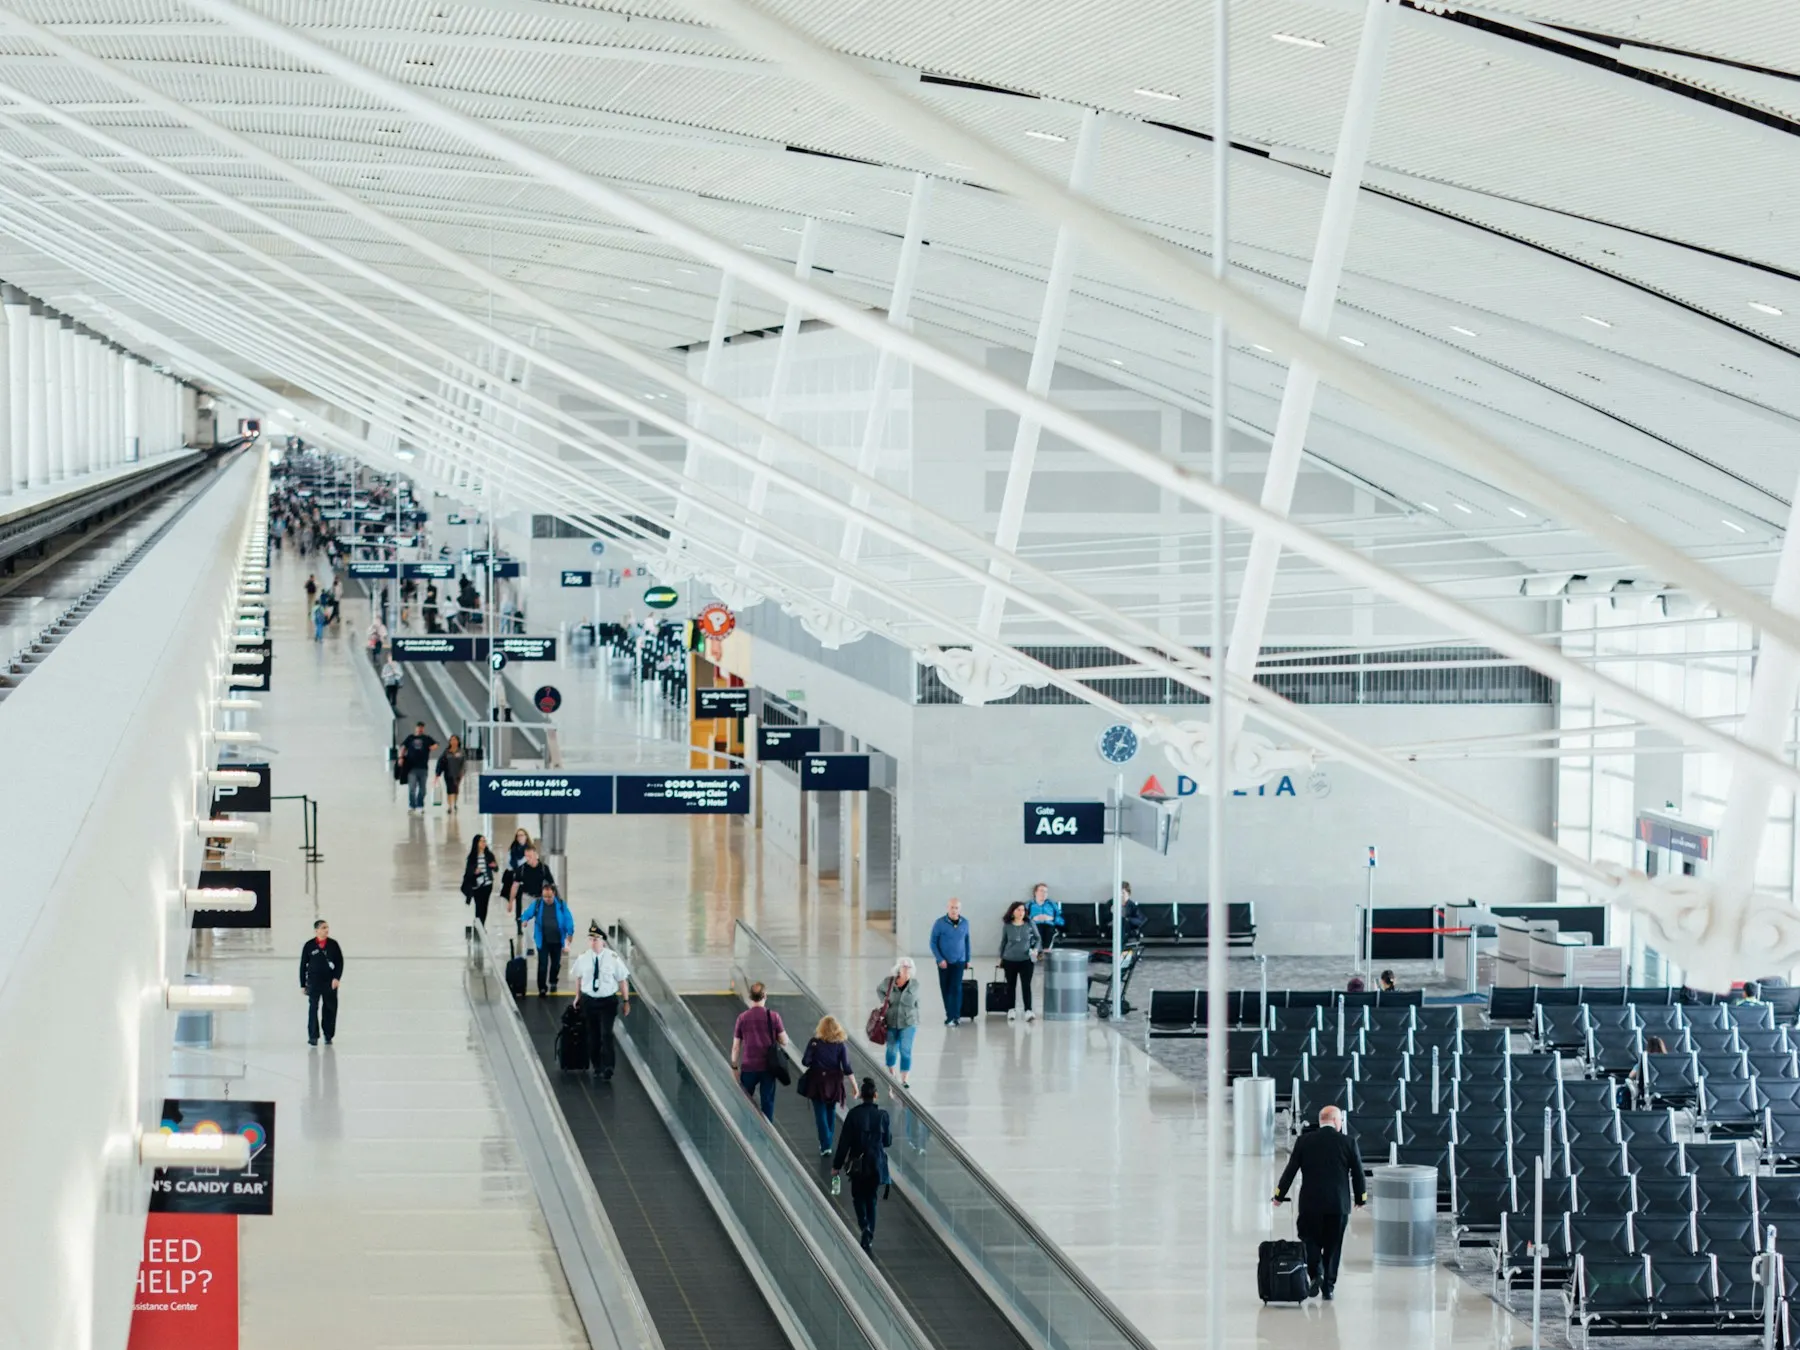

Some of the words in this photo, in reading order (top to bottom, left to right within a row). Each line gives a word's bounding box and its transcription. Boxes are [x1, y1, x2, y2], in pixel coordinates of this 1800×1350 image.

[766, 731, 792, 739] Women
[501, 779, 523, 788] Gates
[523, 779, 534, 788] A1
[536, 779, 545, 788] to
[696, 780, 728, 789] Terminal
[501, 788, 543, 797] Concourses
[543, 788, 550, 797] B
[550, 788, 565, 797] and
[566, 788, 573, 797] C
[674, 789, 705, 799] Luggage
[706, 789, 728, 798] Claim
[706, 798, 728, 807] Hotel
[1035, 806, 1056, 816] Gate
[1035, 817, 1078, 836] A64
[176, 1181, 229, 1193] CANDY
[136, 1269, 213, 1294] HELP?
[170, 1301, 198, 1311] Center
